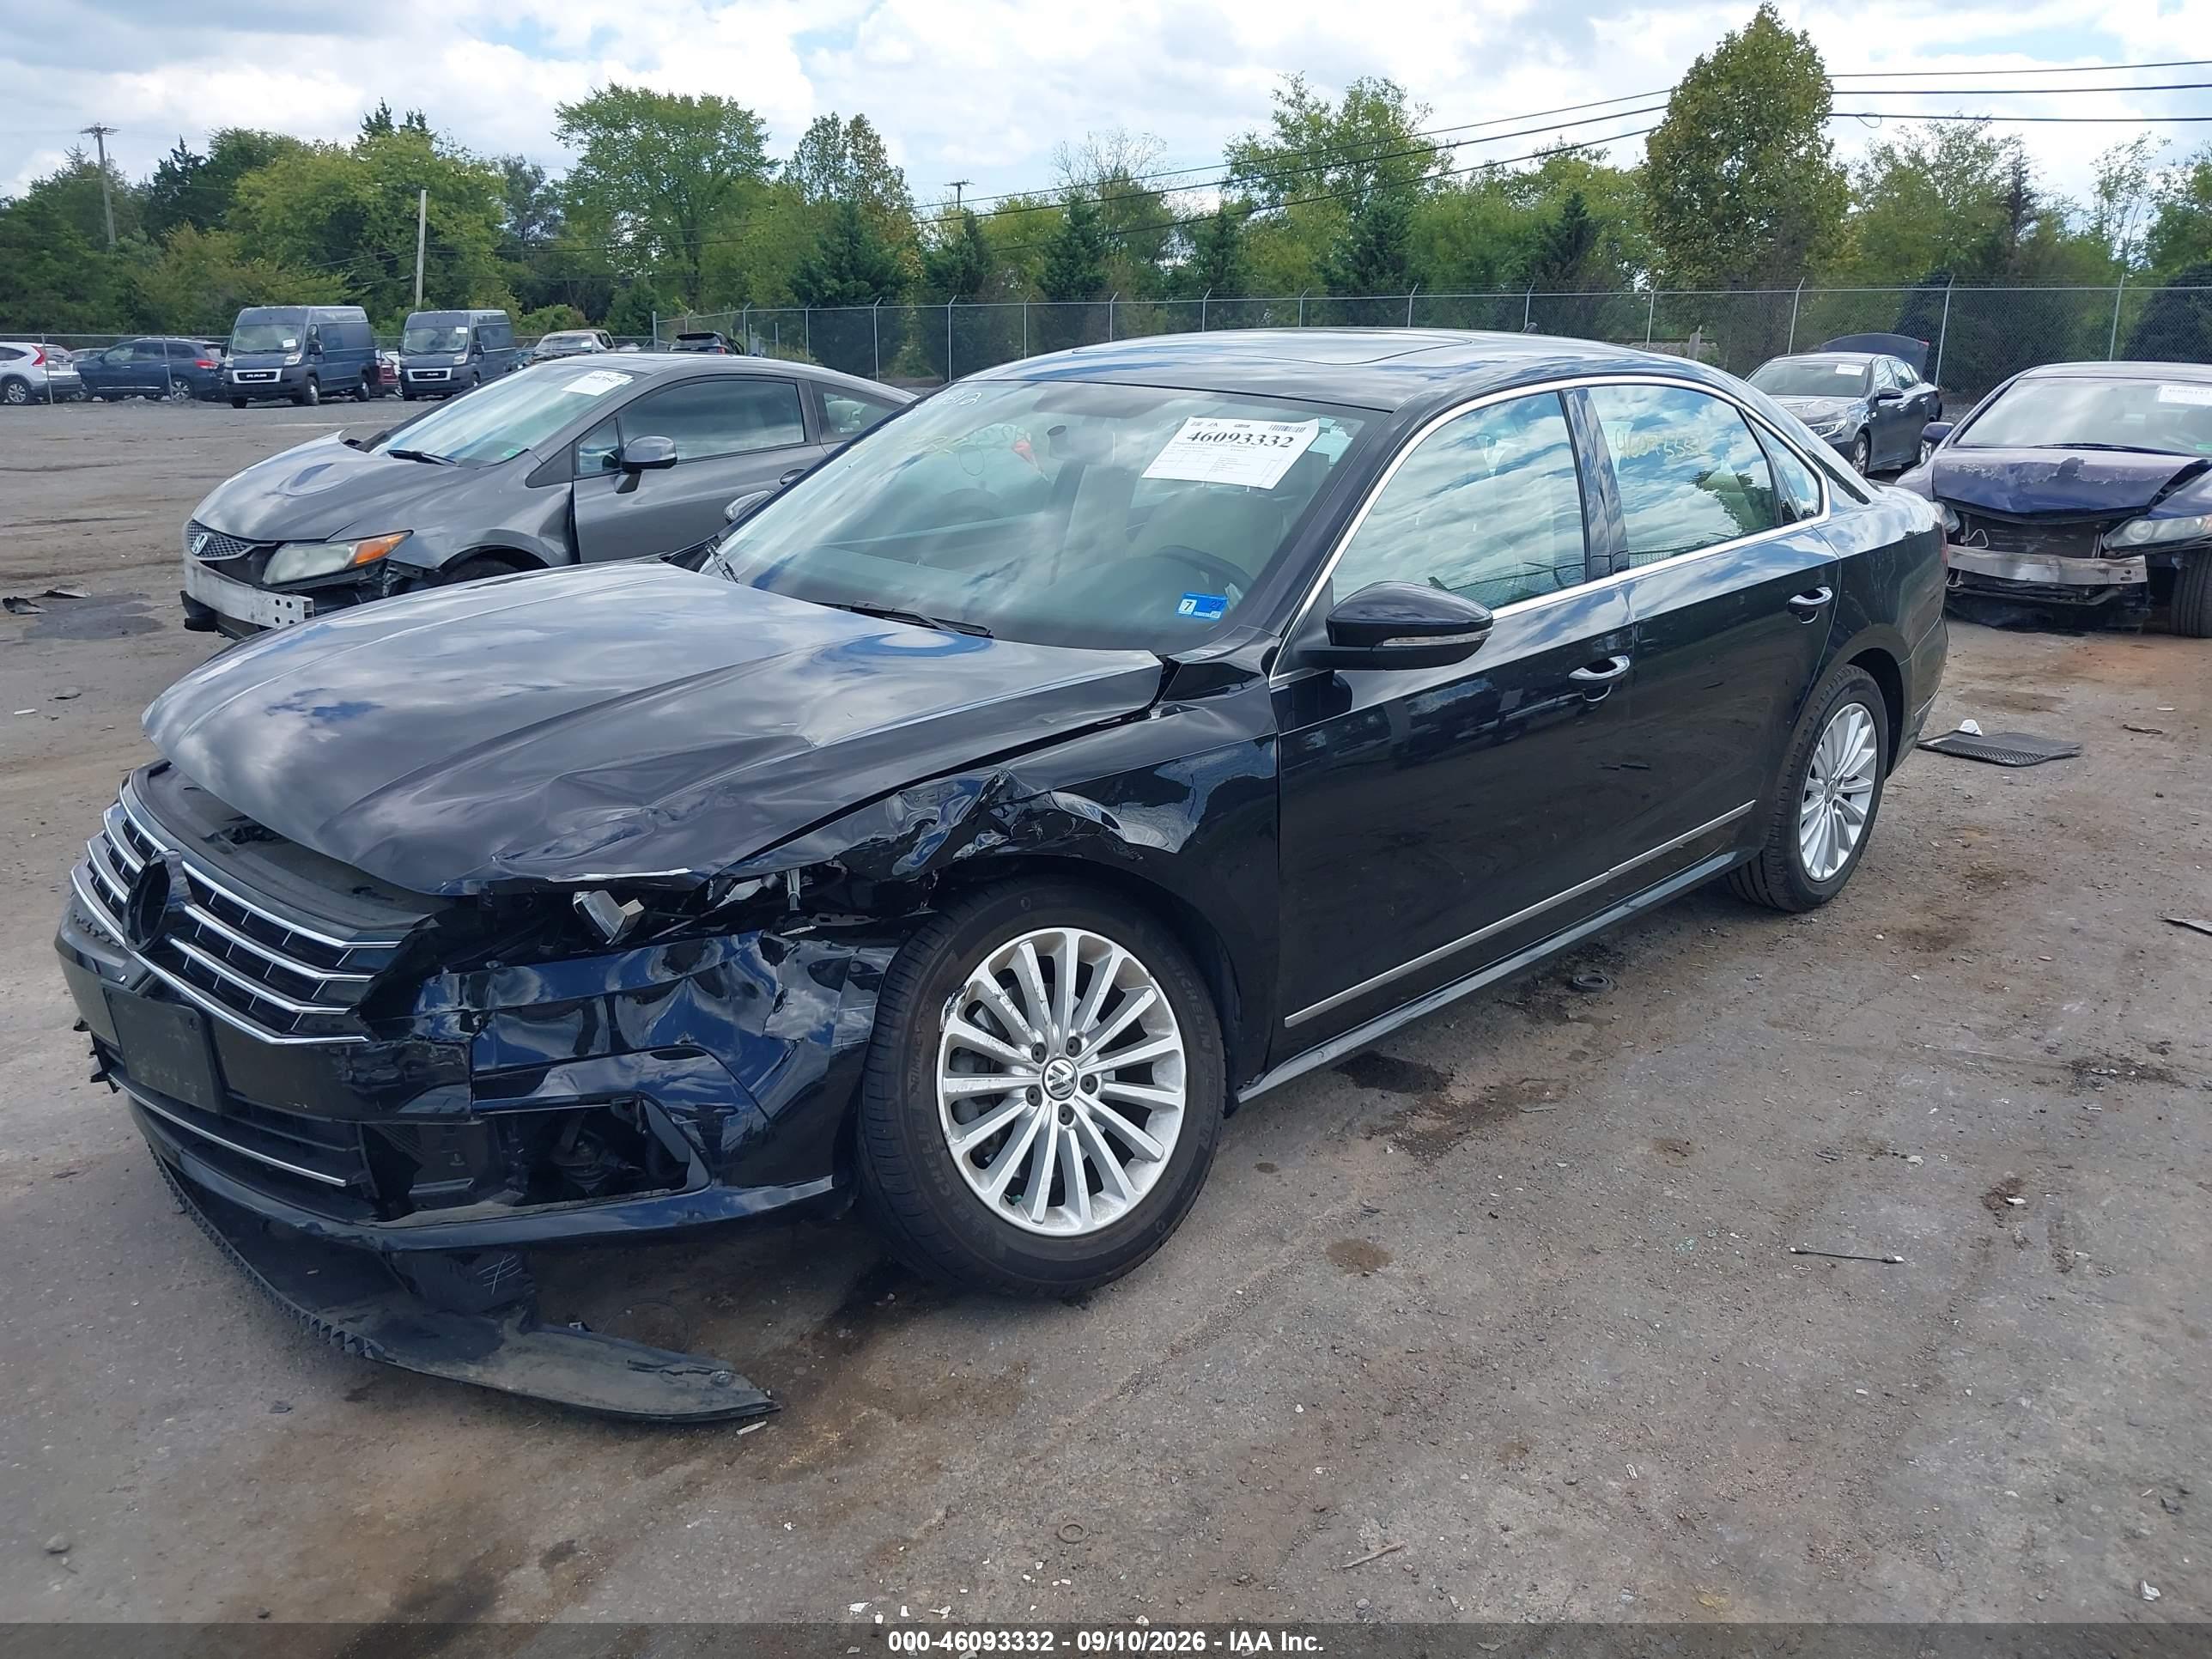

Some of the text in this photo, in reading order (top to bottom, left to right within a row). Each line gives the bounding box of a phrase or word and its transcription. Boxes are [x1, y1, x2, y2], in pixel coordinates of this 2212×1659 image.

[1187, 431, 1294, 447] 46093332
[1184, 601, 1194, 611] 7
[1164, 953, 1212, 1051] MICHELIN
